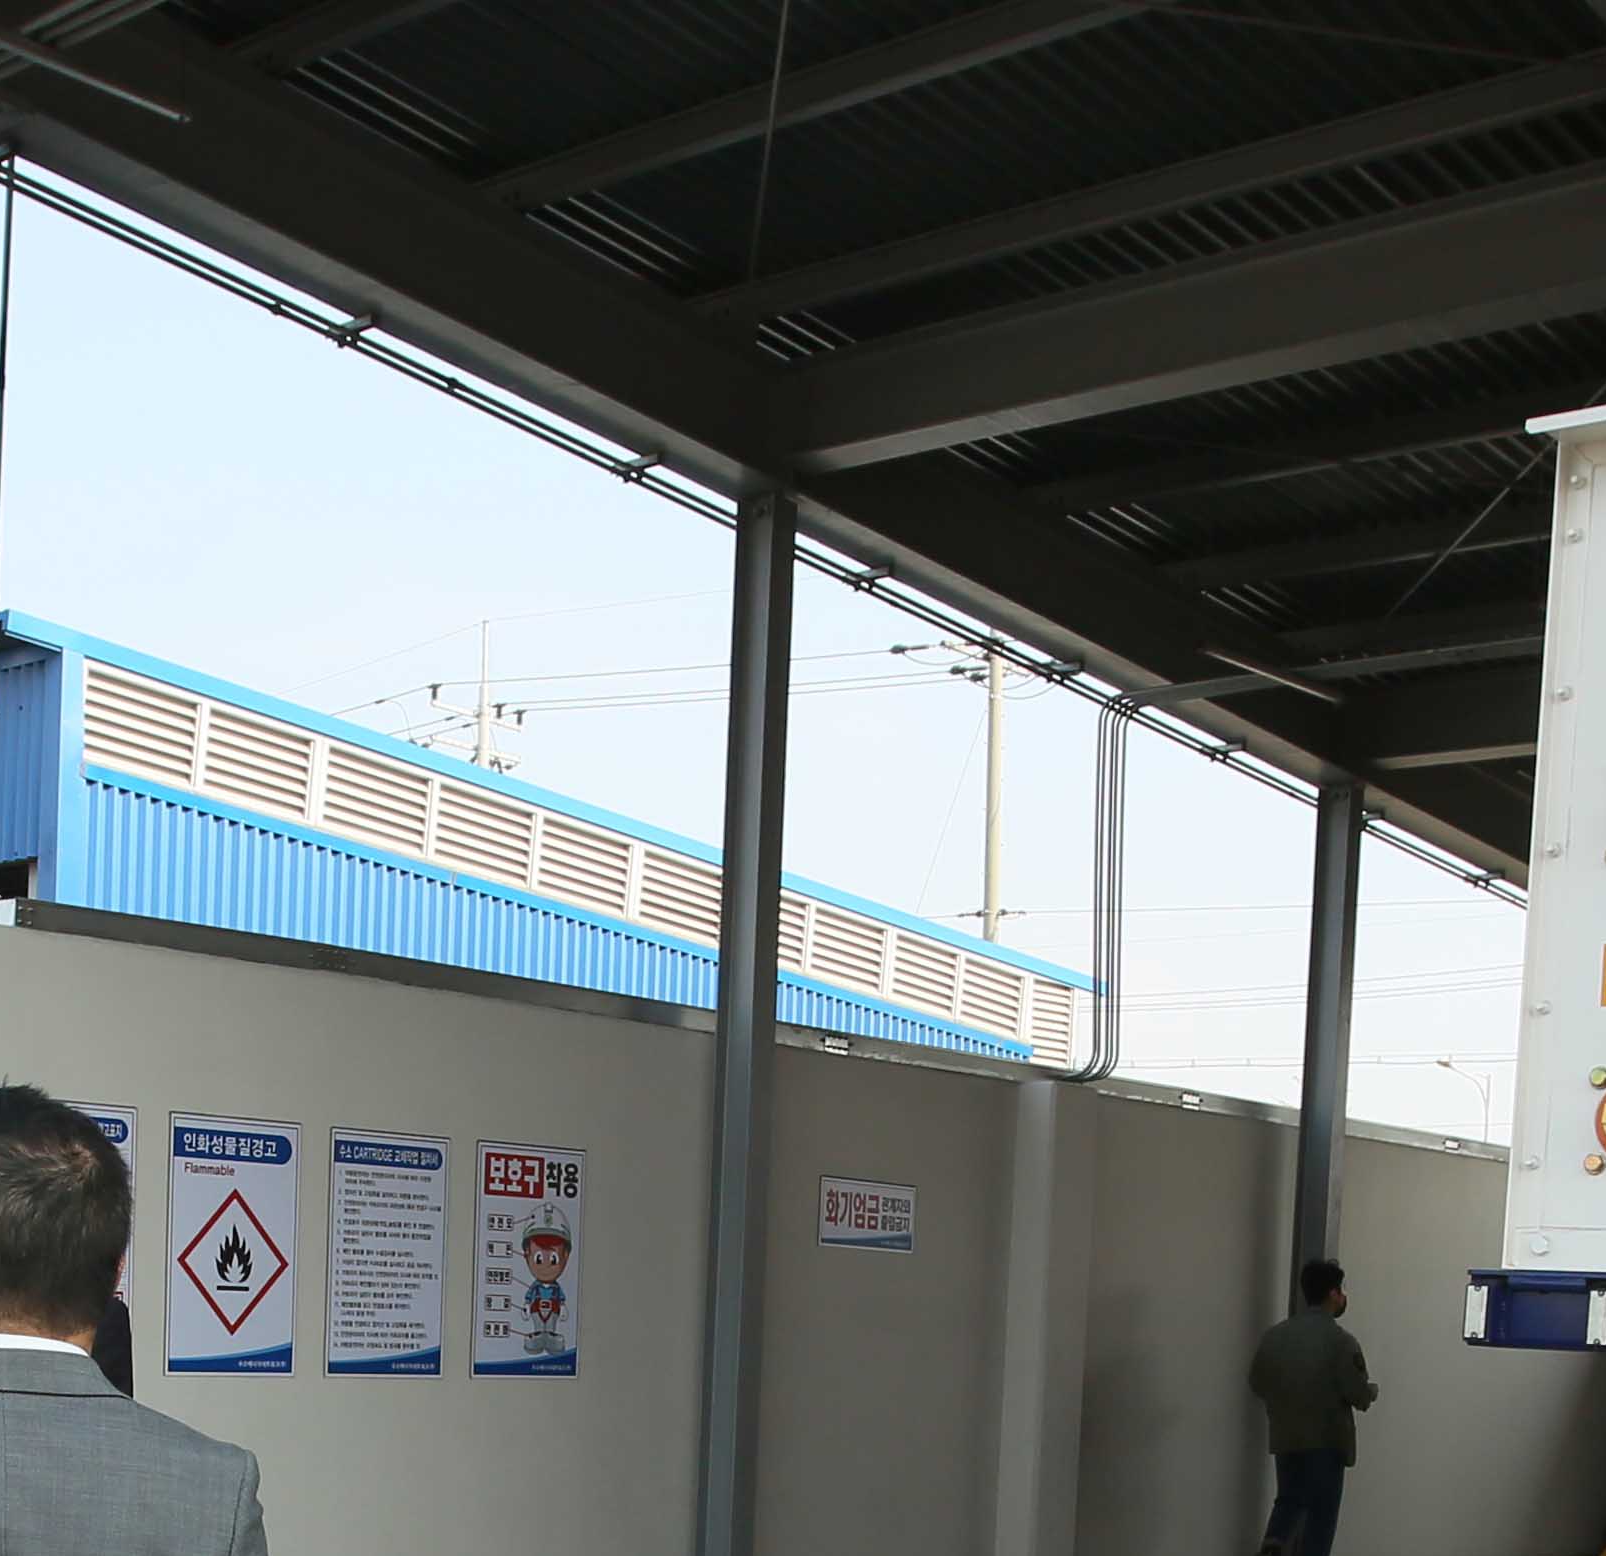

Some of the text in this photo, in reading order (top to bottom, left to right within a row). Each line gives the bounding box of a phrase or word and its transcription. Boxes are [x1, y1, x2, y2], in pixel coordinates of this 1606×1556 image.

[183, 1132, 278, 1159] 인화성물질경고
[338, 1143, 353, 1159] 수소
[353, 1145, 394, 1163] CARTRIDGE
[184, 1161, 236, 1177] Flammable
[488, 1156, 579, 1199] 보호구 착용
[824, 1188, 881, 1231] 화기엄금
